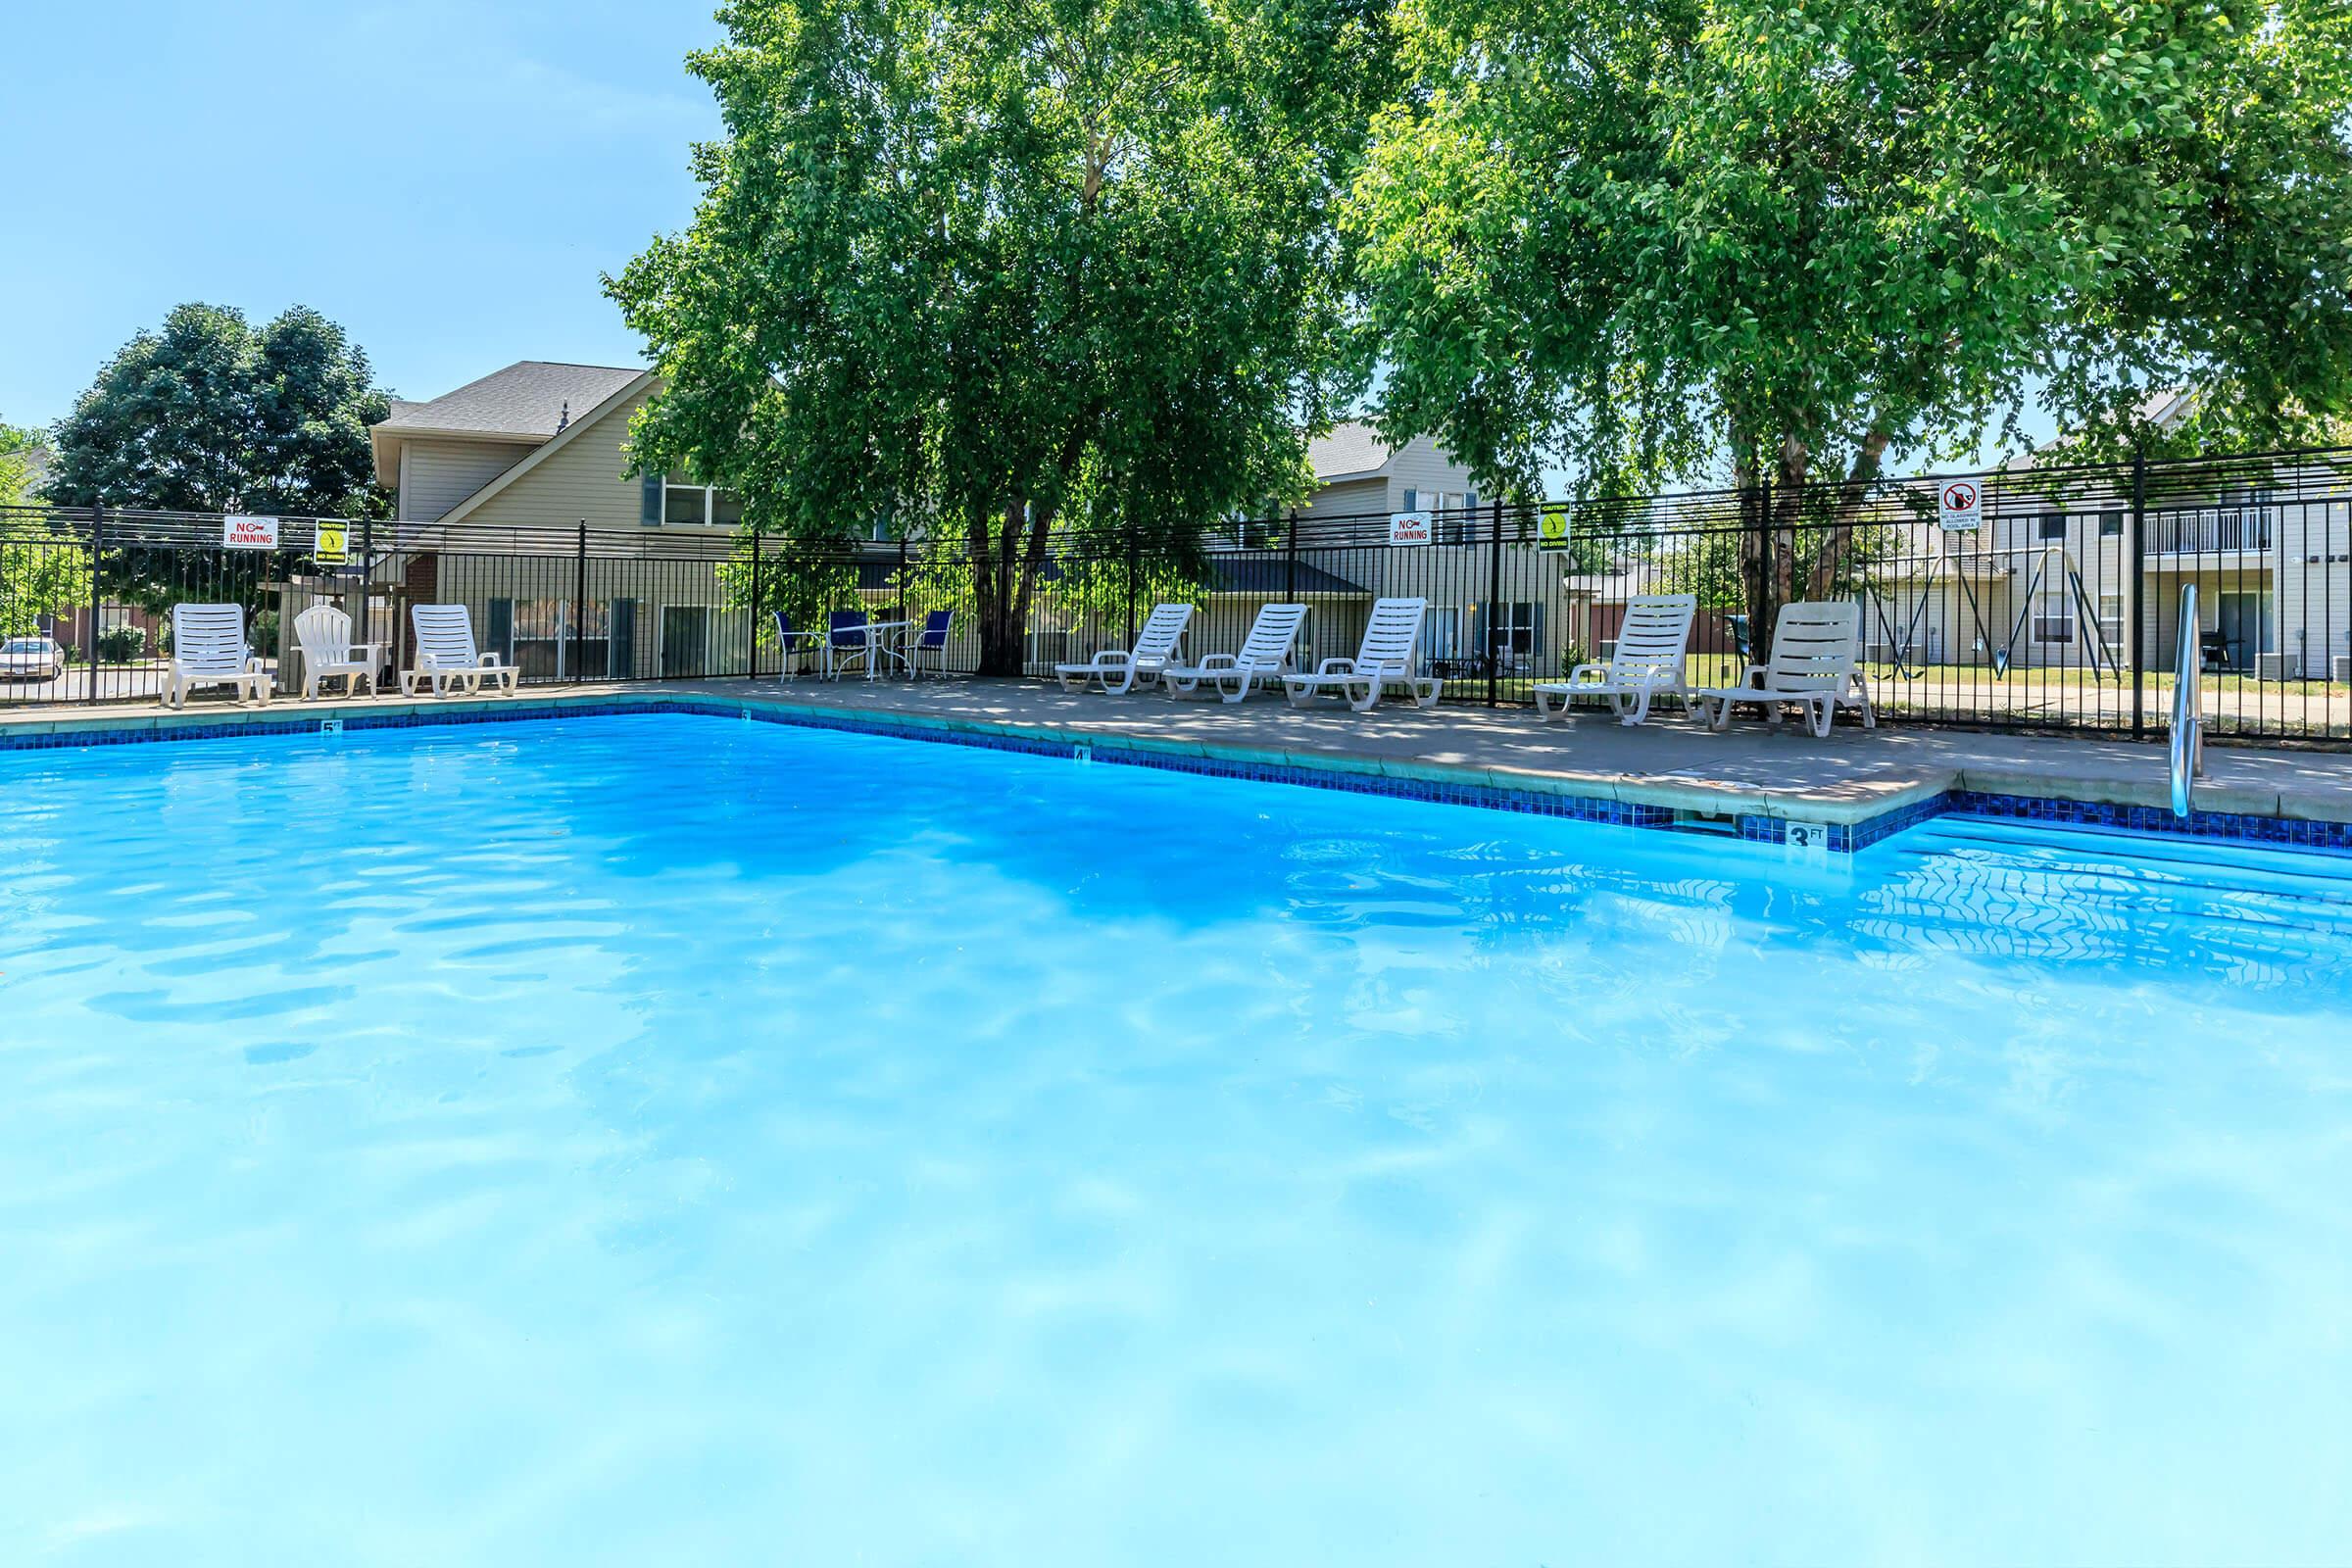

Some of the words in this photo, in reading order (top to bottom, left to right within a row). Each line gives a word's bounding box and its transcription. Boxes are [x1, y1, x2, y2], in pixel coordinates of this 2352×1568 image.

[236, 522, 256, 532] NO
[1398, 519, 1413, 529] NO
[229, 533, 272, 543] RUNNING
[1394, 529, 1427, 541] RUNNING
[323, 722, 333, 731] 5
[1790, 827, 1808, 847] 3
[1811, 829, 1823, 839] FT
